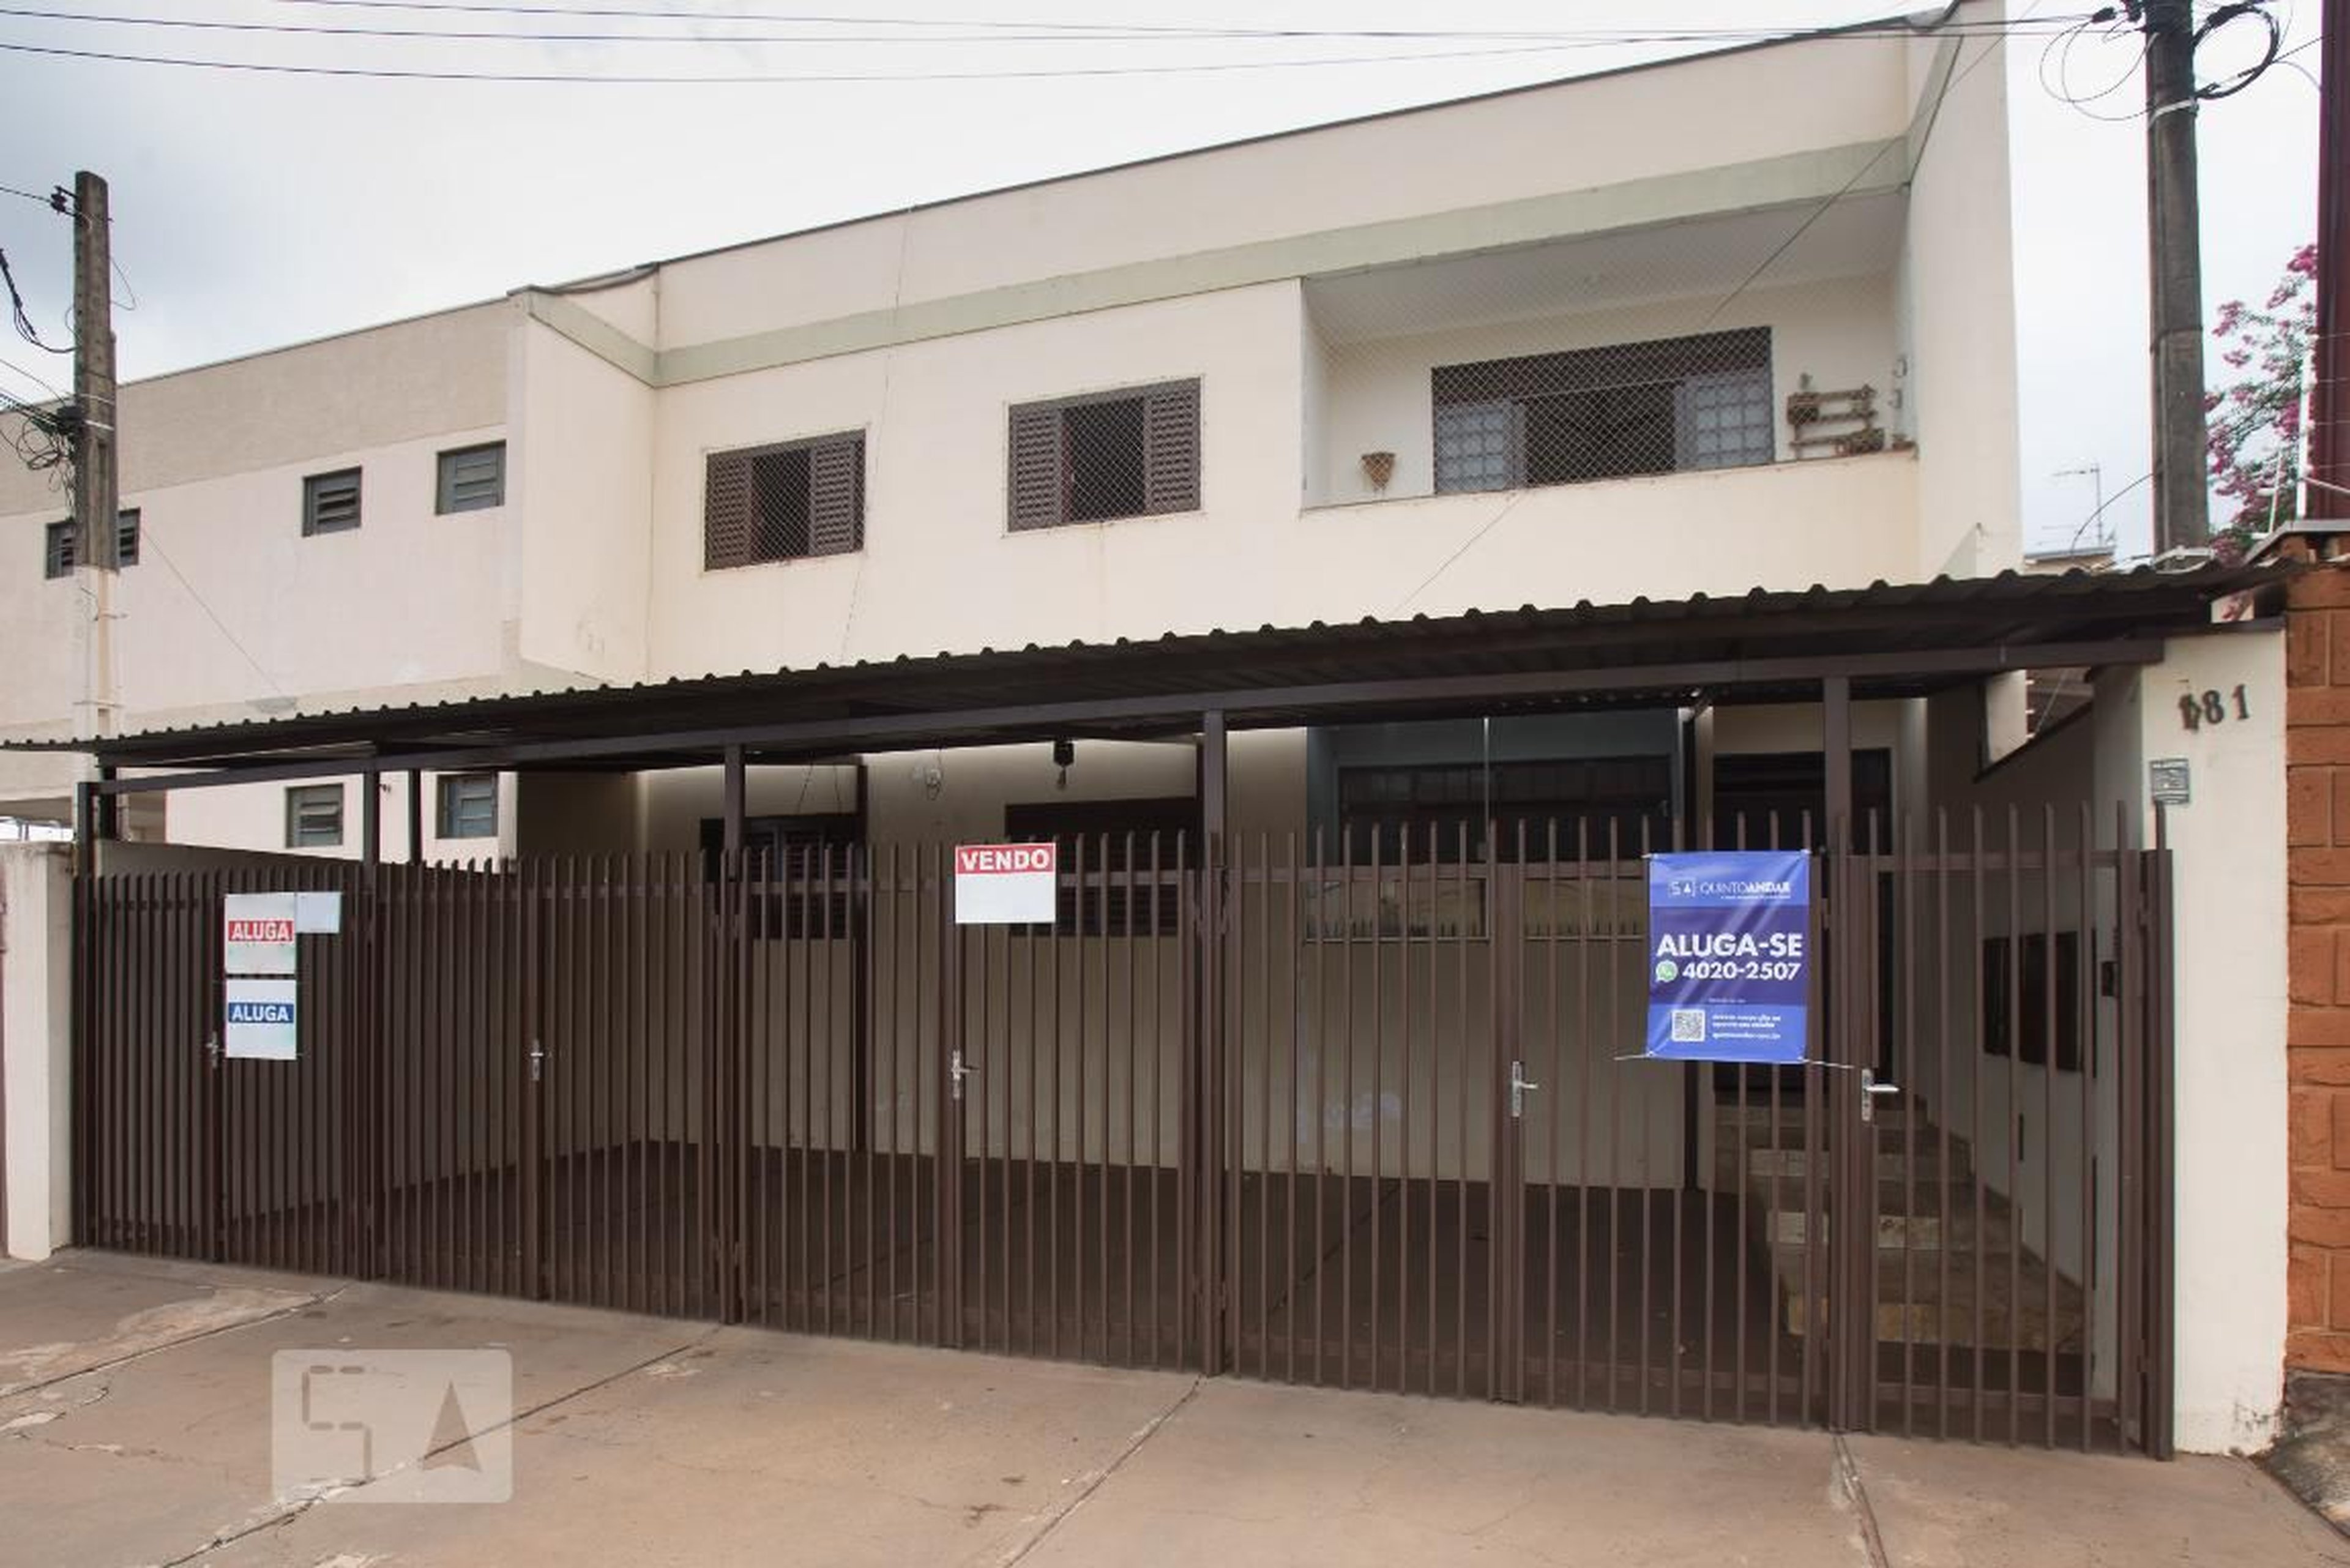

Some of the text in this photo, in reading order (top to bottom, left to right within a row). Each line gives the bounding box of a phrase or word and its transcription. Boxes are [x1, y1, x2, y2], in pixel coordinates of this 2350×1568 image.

[960, 848, 1050, 870] VENDO
[231, 922, 290, 941] ALUGA
[1656, 933, 1803, 957] ALUGA-SE
[1682, 961, 1802, 980] 4020-2507
[231, 1005, 289, 1022] ALUGA
